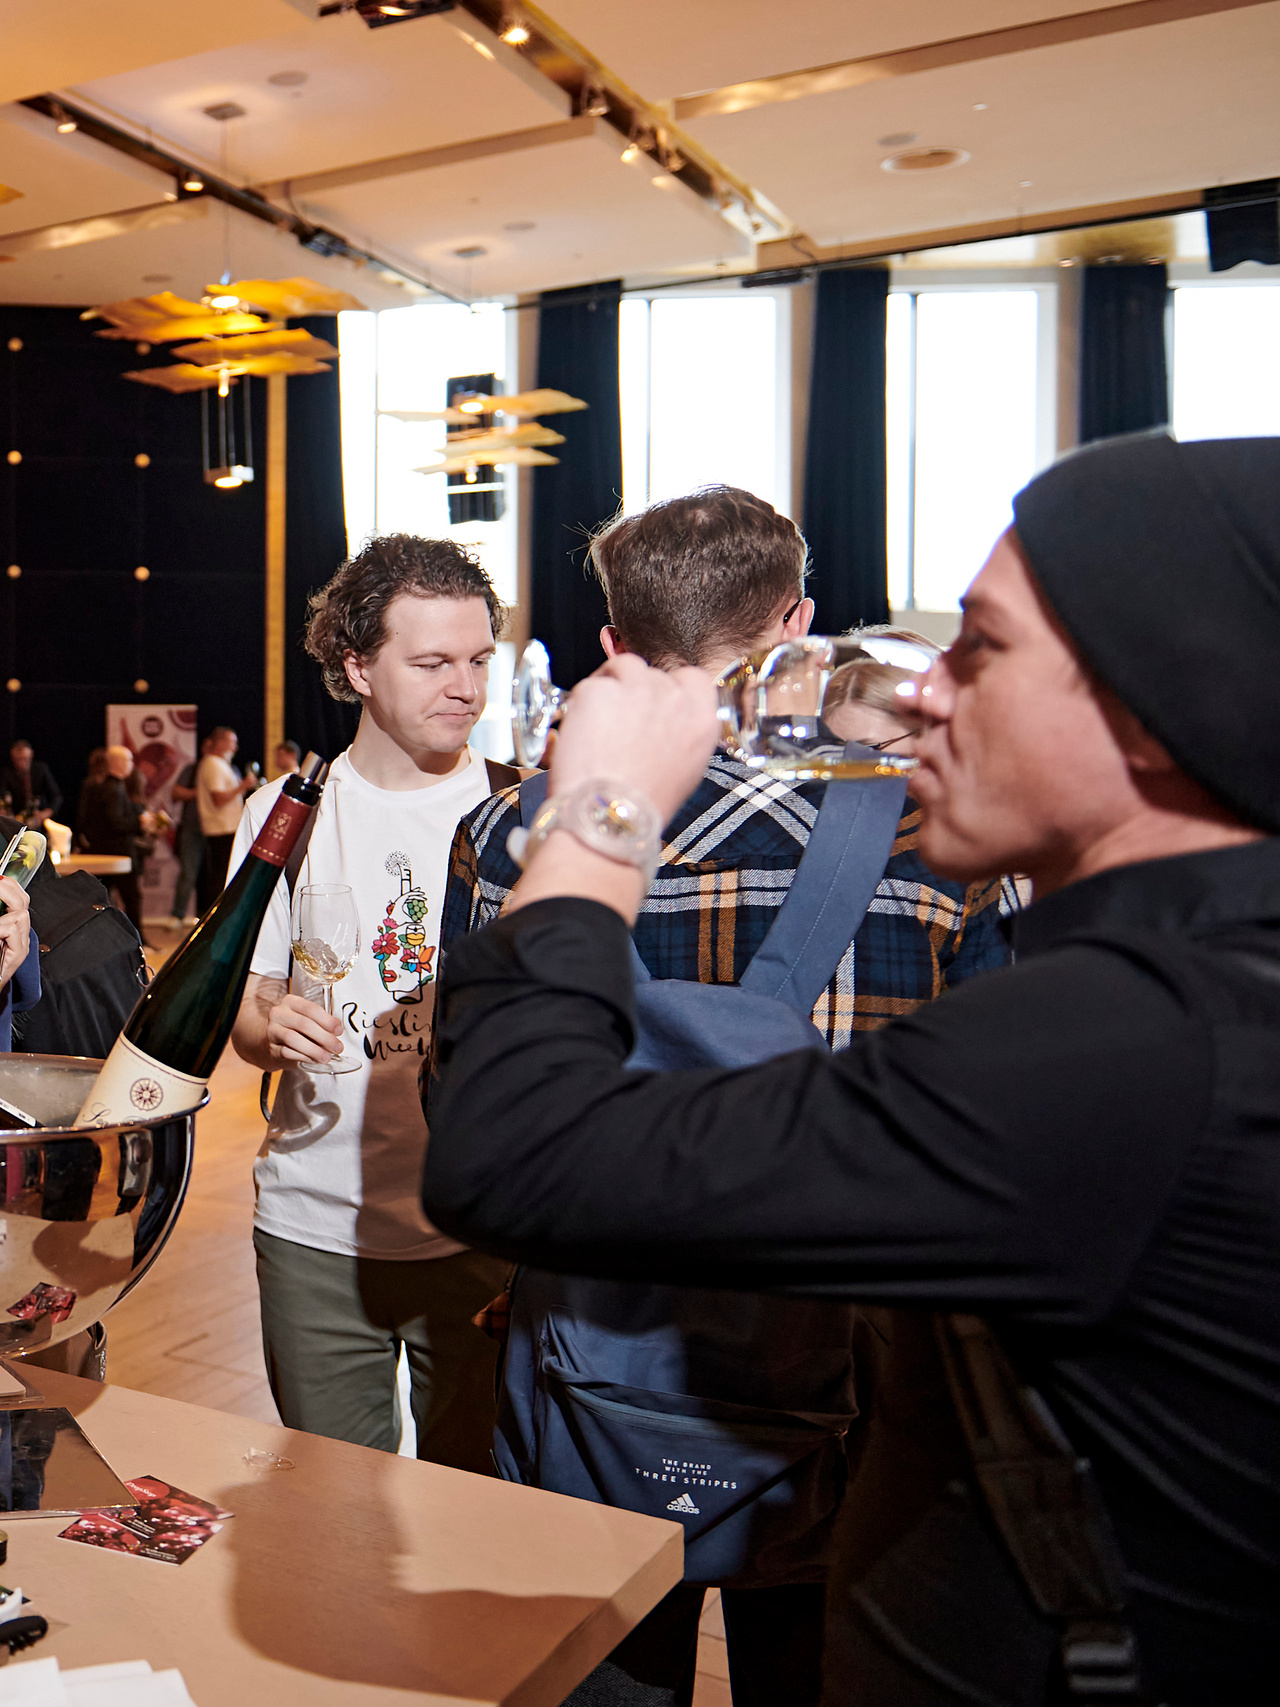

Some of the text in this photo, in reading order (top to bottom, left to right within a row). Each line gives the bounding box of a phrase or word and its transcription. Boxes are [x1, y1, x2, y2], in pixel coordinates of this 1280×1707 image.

[341, 1001, 432, 1037] Rieslin
[662, 1458, 712, 1471] THE BRAND
[664, 1465, 687, 1474] WITH
[635, 1467, 738, 1490] THREE STRIPES
[666, 1504, 701, 1515] adidas
